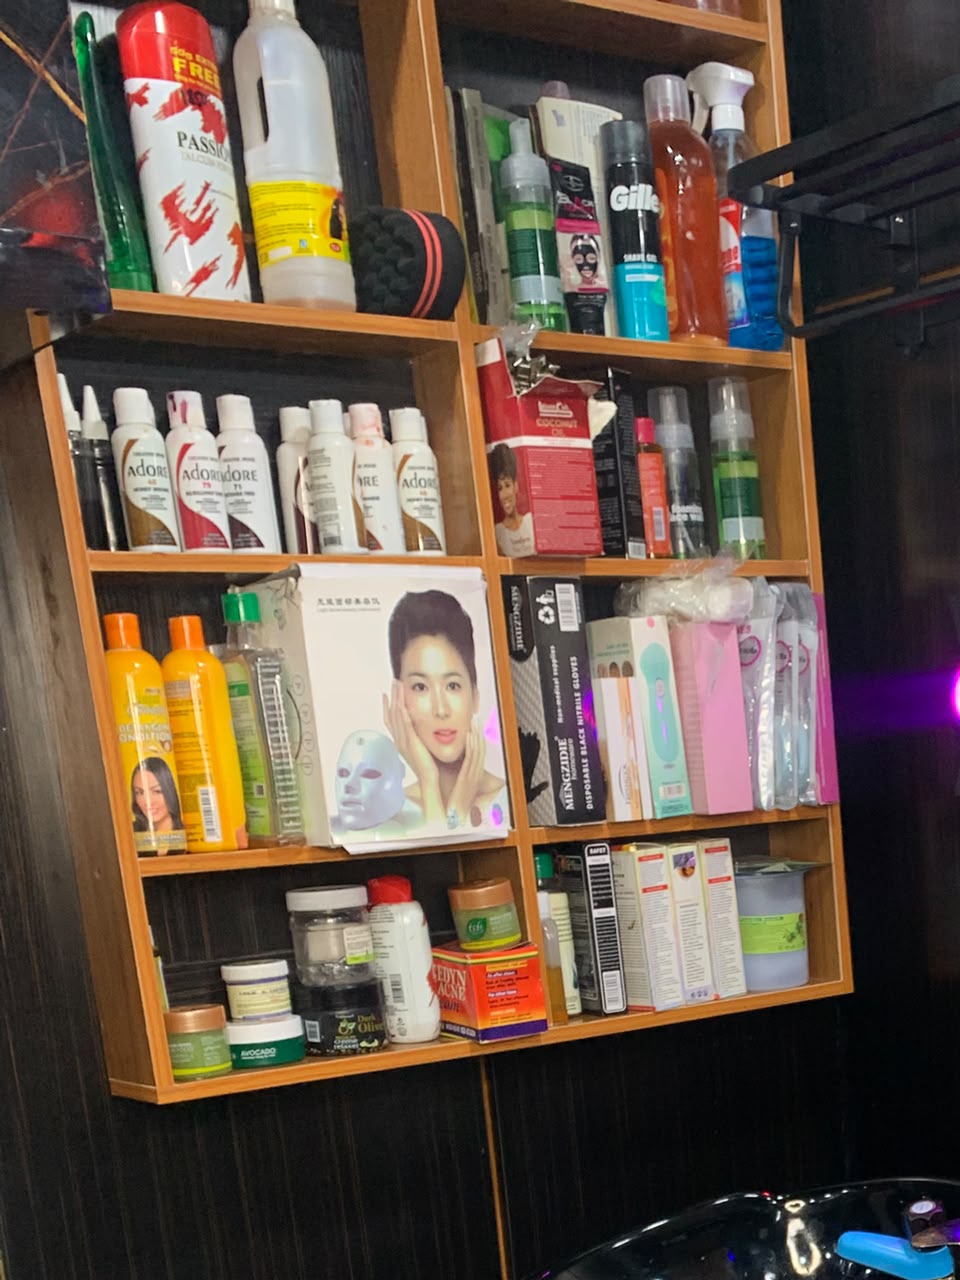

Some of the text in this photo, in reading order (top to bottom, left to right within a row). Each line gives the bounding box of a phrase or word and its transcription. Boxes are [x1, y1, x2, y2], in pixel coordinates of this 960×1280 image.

[569, 655, 581, 690] GLOVES
[578, 727, 589, 756] BLACK
[581, 756, 594, 810] DISPOSABLE
[240, 1047, 277, 1058] AVOCADO
